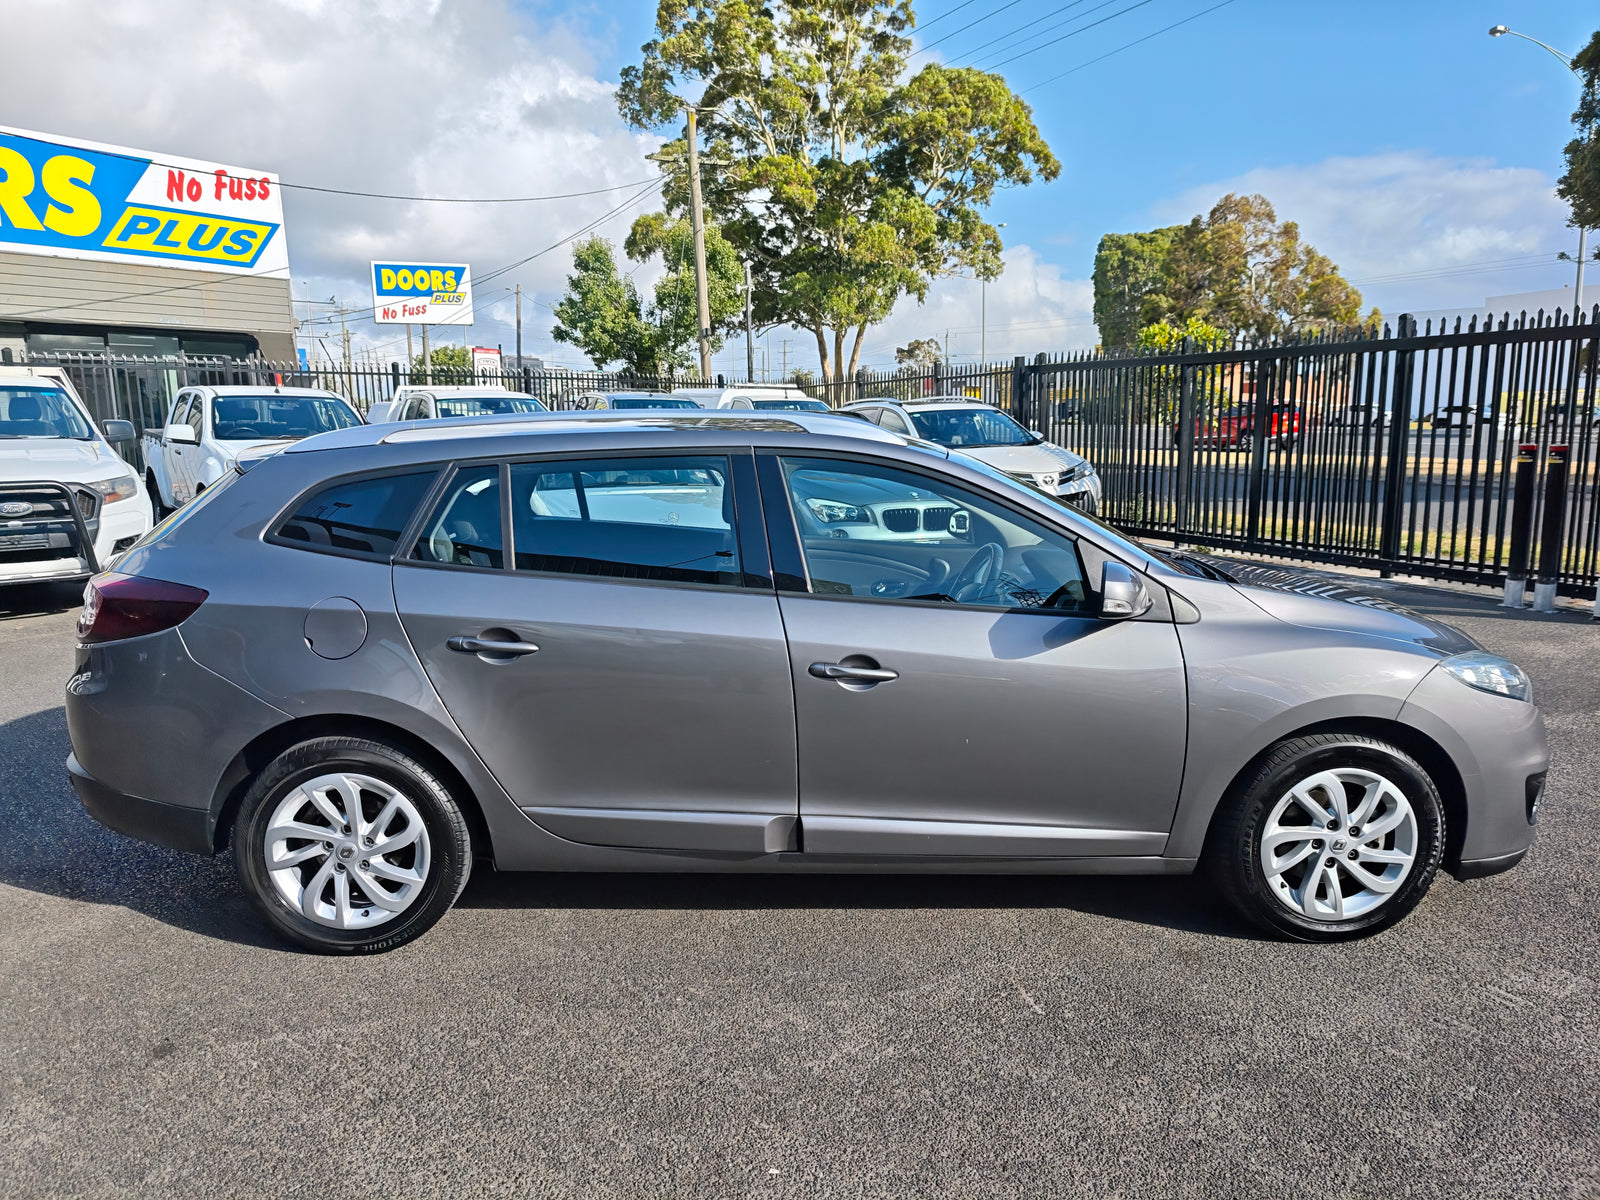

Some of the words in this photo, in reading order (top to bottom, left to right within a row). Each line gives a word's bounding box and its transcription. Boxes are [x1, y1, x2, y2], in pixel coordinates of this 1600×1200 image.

[166, 169, 203, 203] No
[214, 169, 271, 202] Fuss
[116, 214, 258, 256] PLUS
[381, 268, 457, 292] DOORS
[434, 294, 462, 303] PLUS
[382, 307, 397, 320] No
[402, 304, 427, 317] Fuss
[2, 503, 26, 513] Ford
